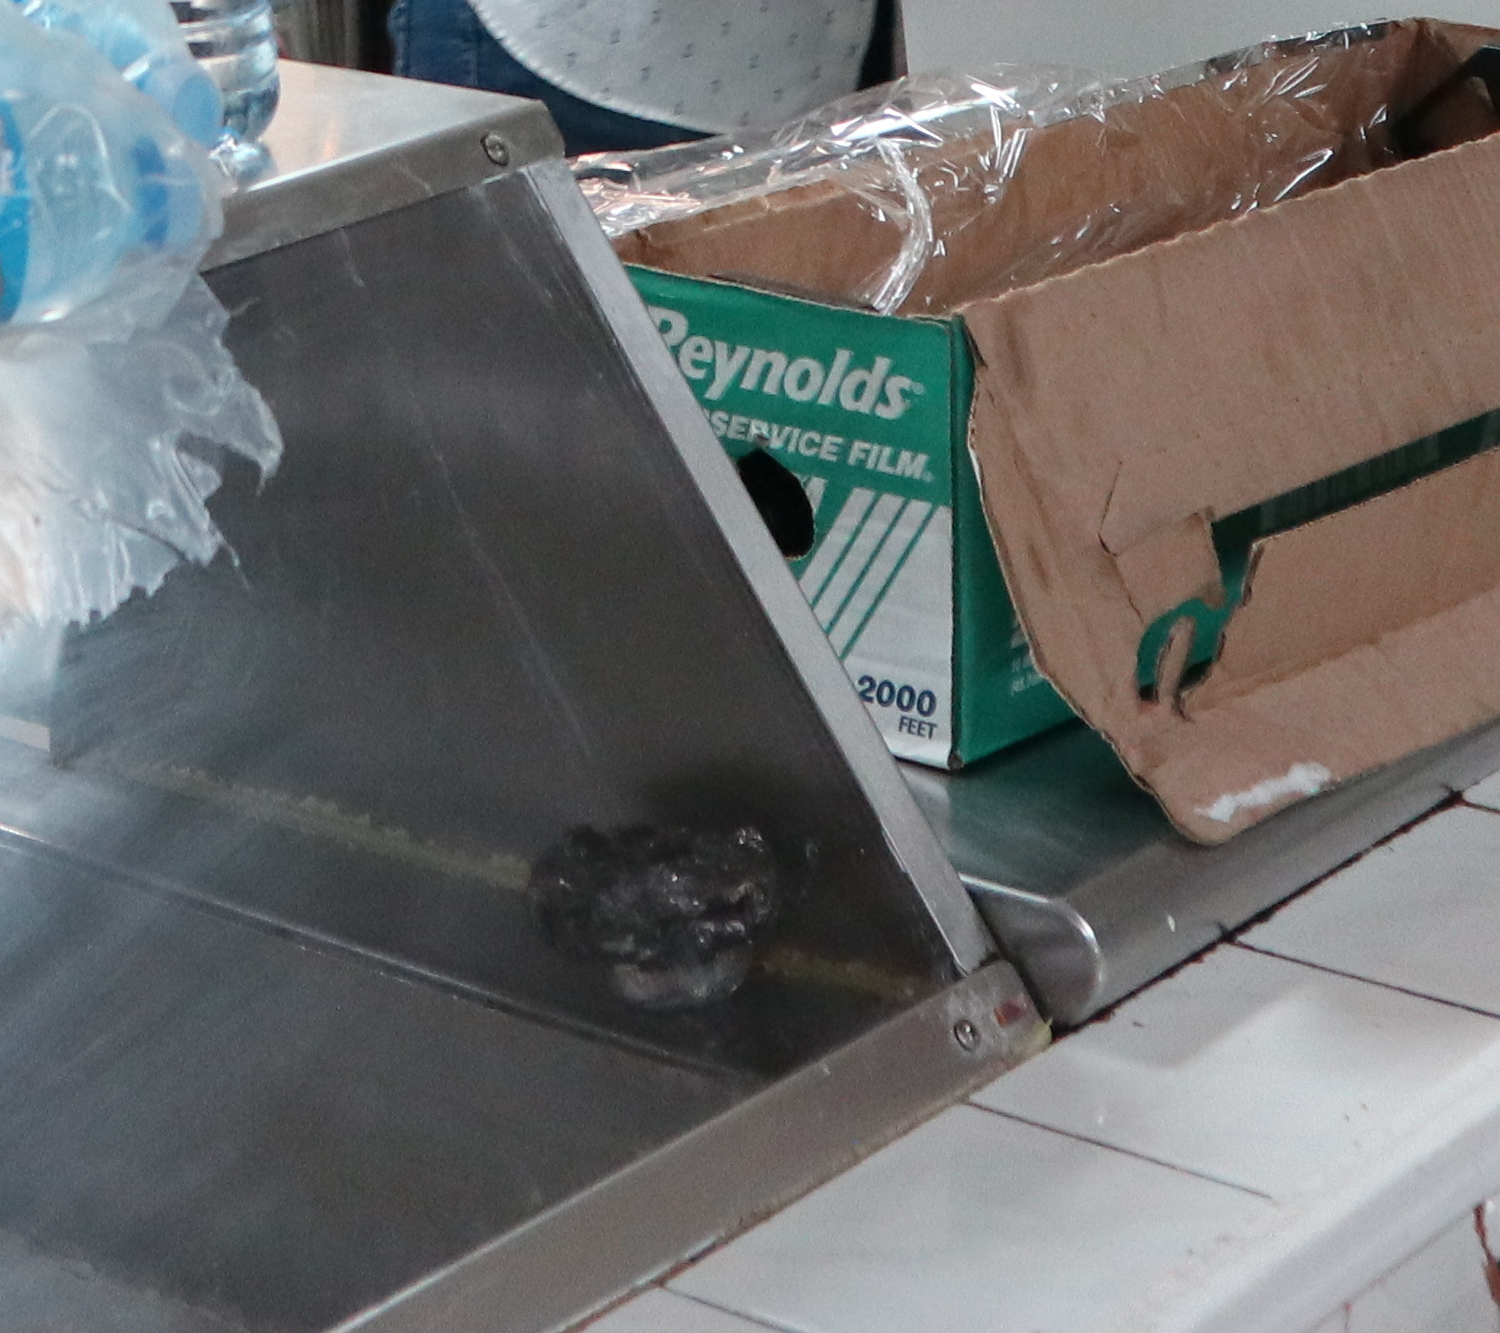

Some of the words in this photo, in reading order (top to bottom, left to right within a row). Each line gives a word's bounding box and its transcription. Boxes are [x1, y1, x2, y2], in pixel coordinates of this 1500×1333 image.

[651, 305, 914, 420] Reynolds
[704, 408, 843, 463] SERVICE
[857, 674, 937, 720] 2000
[899, 716, 938, 742] FEET
